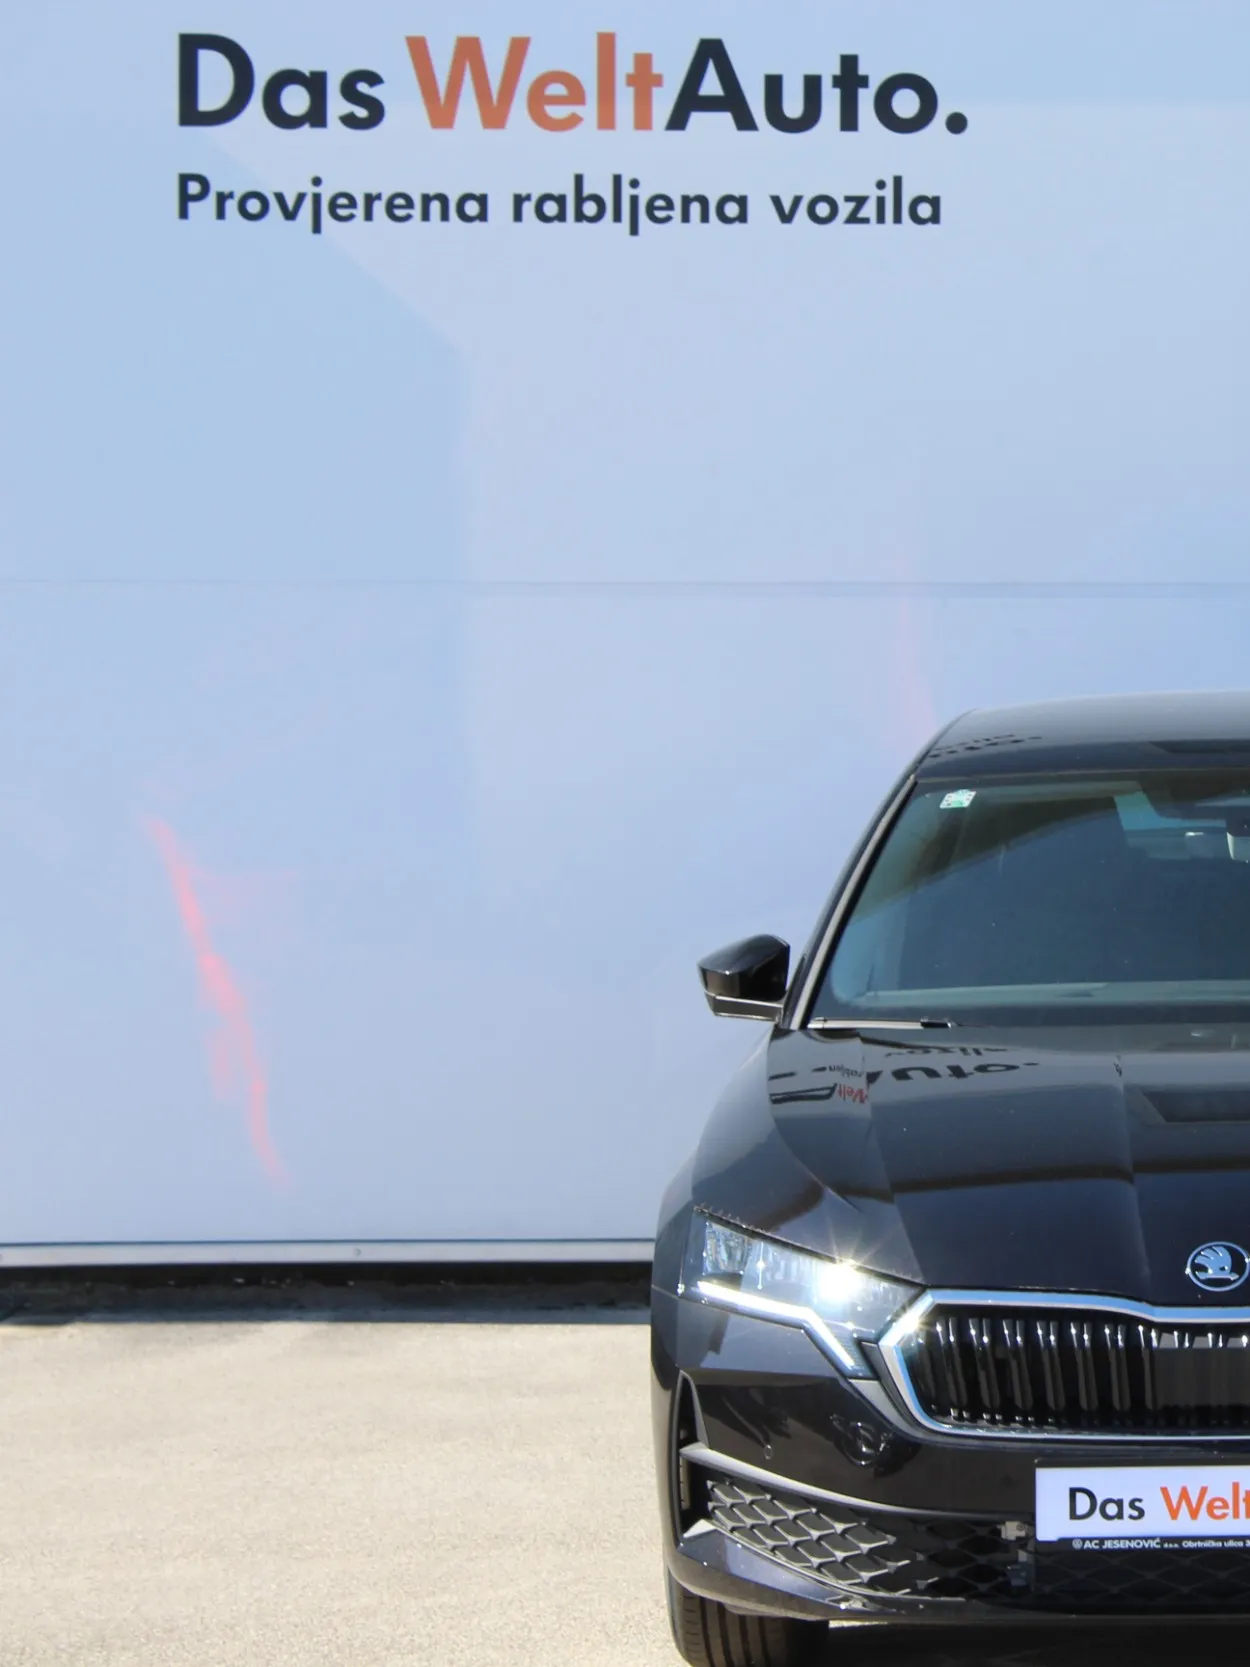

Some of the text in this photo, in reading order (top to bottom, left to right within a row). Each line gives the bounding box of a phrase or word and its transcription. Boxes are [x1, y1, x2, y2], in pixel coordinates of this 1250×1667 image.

[178, 31, 969, 136] Das WeltAuto.
[177, 172, 942, 237] Provjerena rabljena vozila
[1068, 1486, 1146, 1521] Das
[1083, 1539, 1099, 1549] AC
[1101, 1537, 1161, 1549] JESENOVIĆ
[1224, 1539, 1243, 1548] ulica
